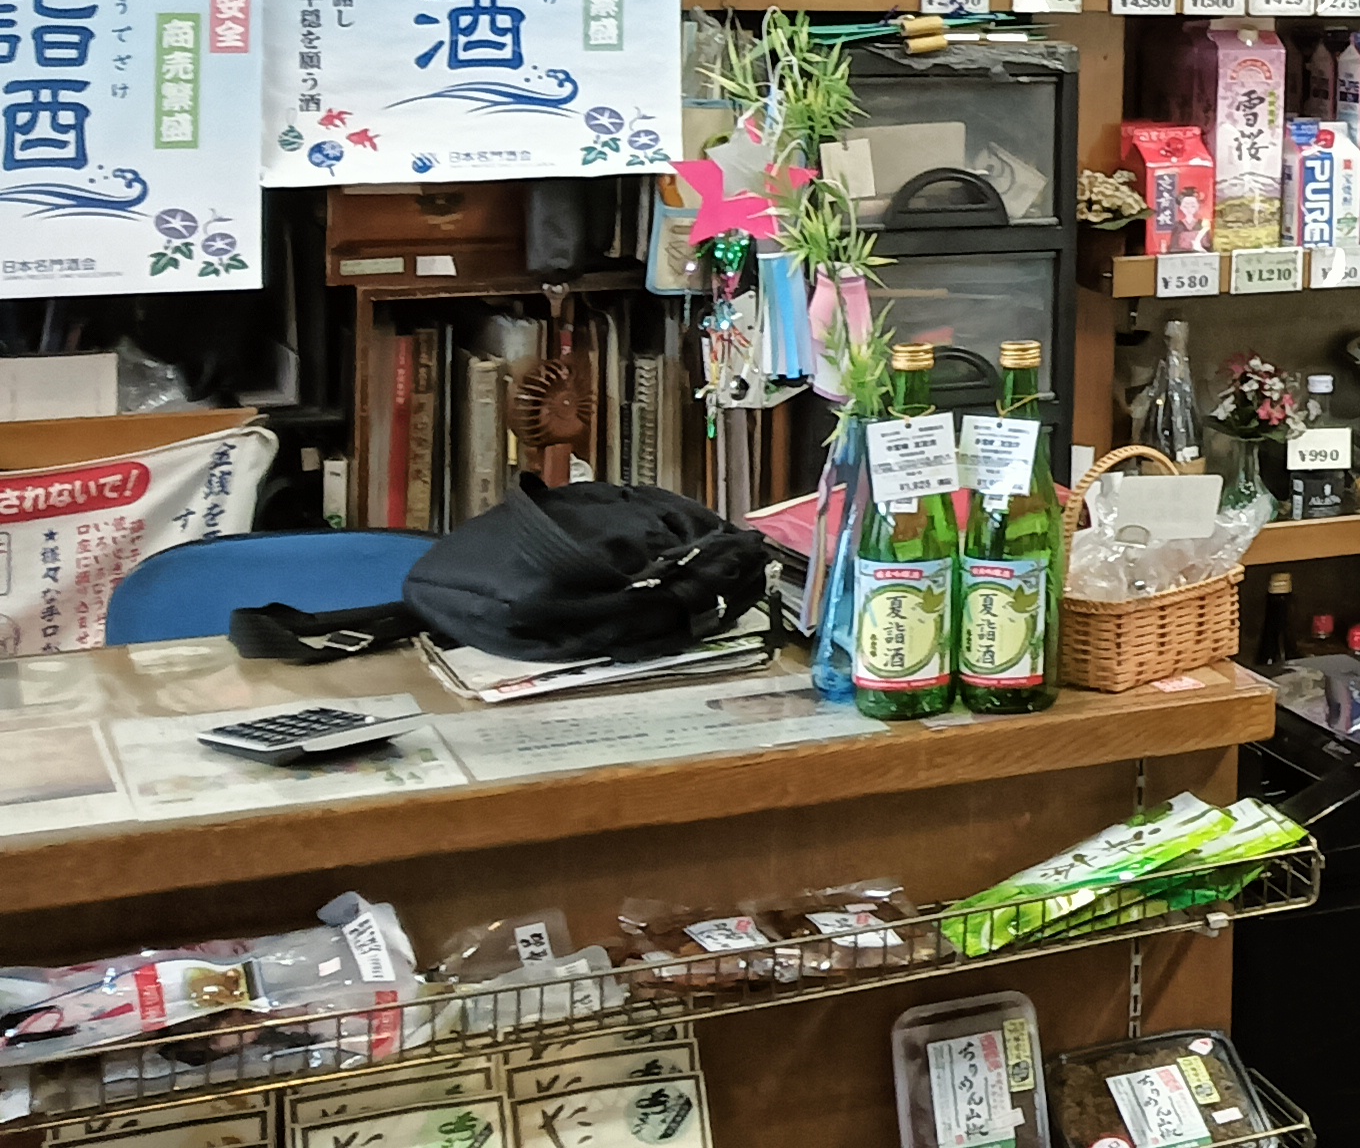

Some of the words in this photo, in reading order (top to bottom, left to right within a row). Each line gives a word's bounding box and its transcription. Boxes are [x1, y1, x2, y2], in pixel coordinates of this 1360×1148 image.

[160, 15, 195, 144] 商売繁盛
[1304, 159, 1332, 248] PURE
[1161, 275, 1210, 289] ¥580
[1298, 448, 1341, 463] ¥990
